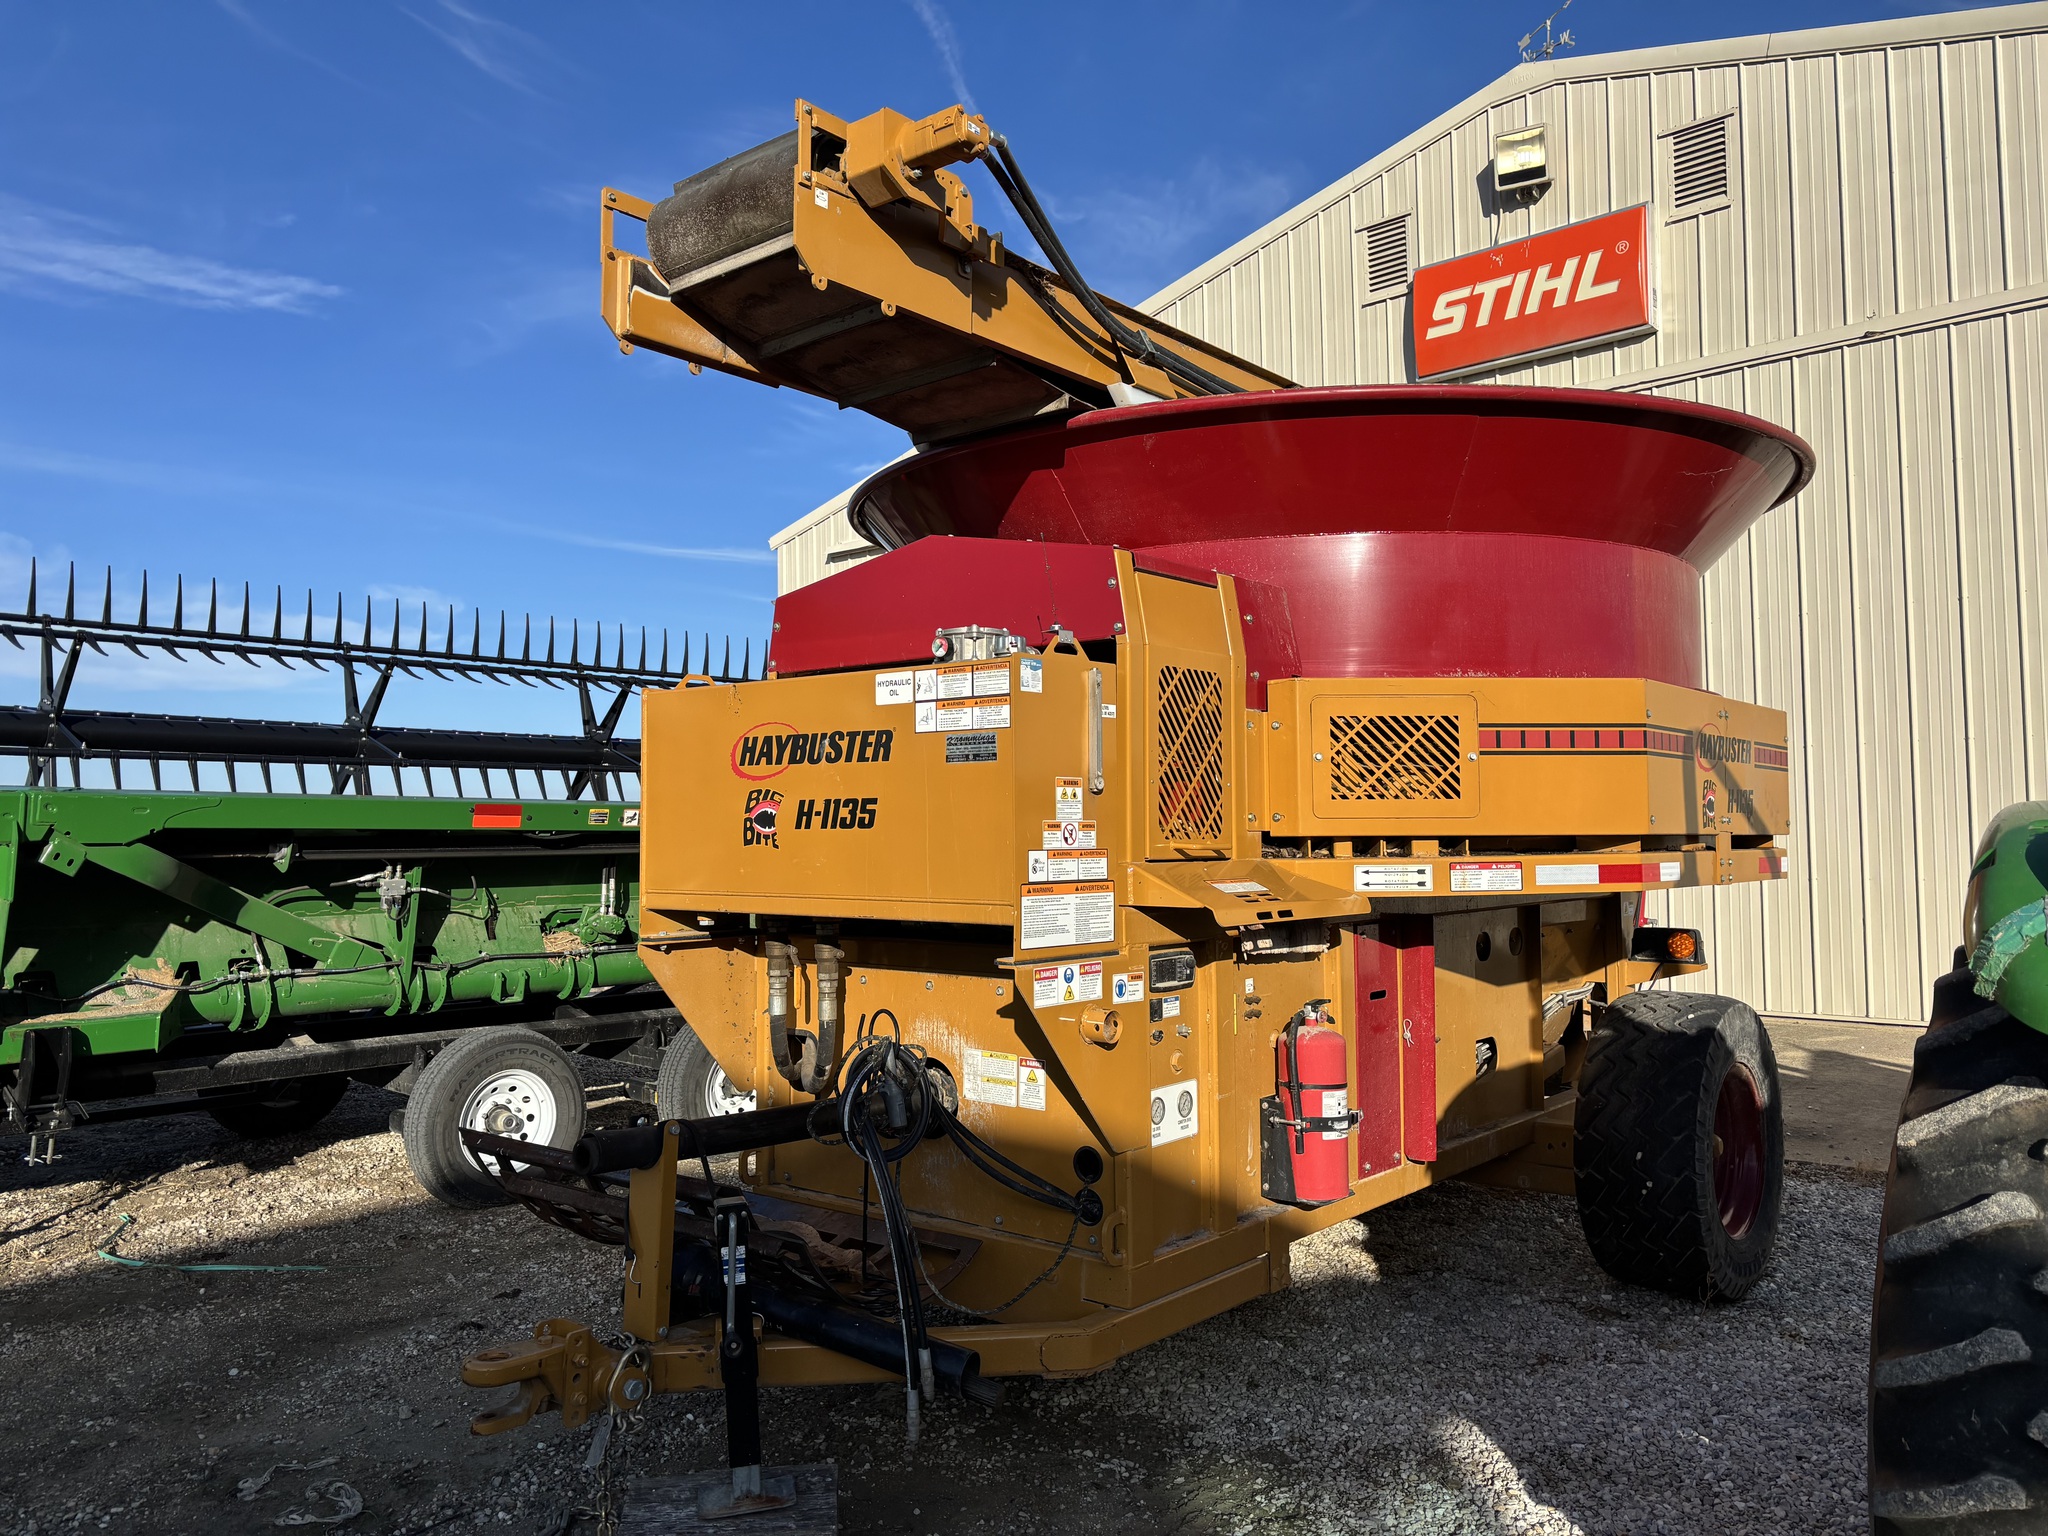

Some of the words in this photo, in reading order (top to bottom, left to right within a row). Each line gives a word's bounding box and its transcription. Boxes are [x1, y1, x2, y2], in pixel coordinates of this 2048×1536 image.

[1425, 248, 1621, 341] STIHL
[877, 678, 912, 688] HYDRAULIC
[889, 689, 900, 697] OIL
[739, 729, 894, 767] HAYBUSTER
[1700, 732, 1752, 764] HAYBUSTER
[794, 797, 879, 830] H-1135
[1032, 886, 1054, 894] WARNING
[1079, 884, 1110, 893] ADVERTENCIA
[449, 1047, 558, 1102] MASTERTRACK
